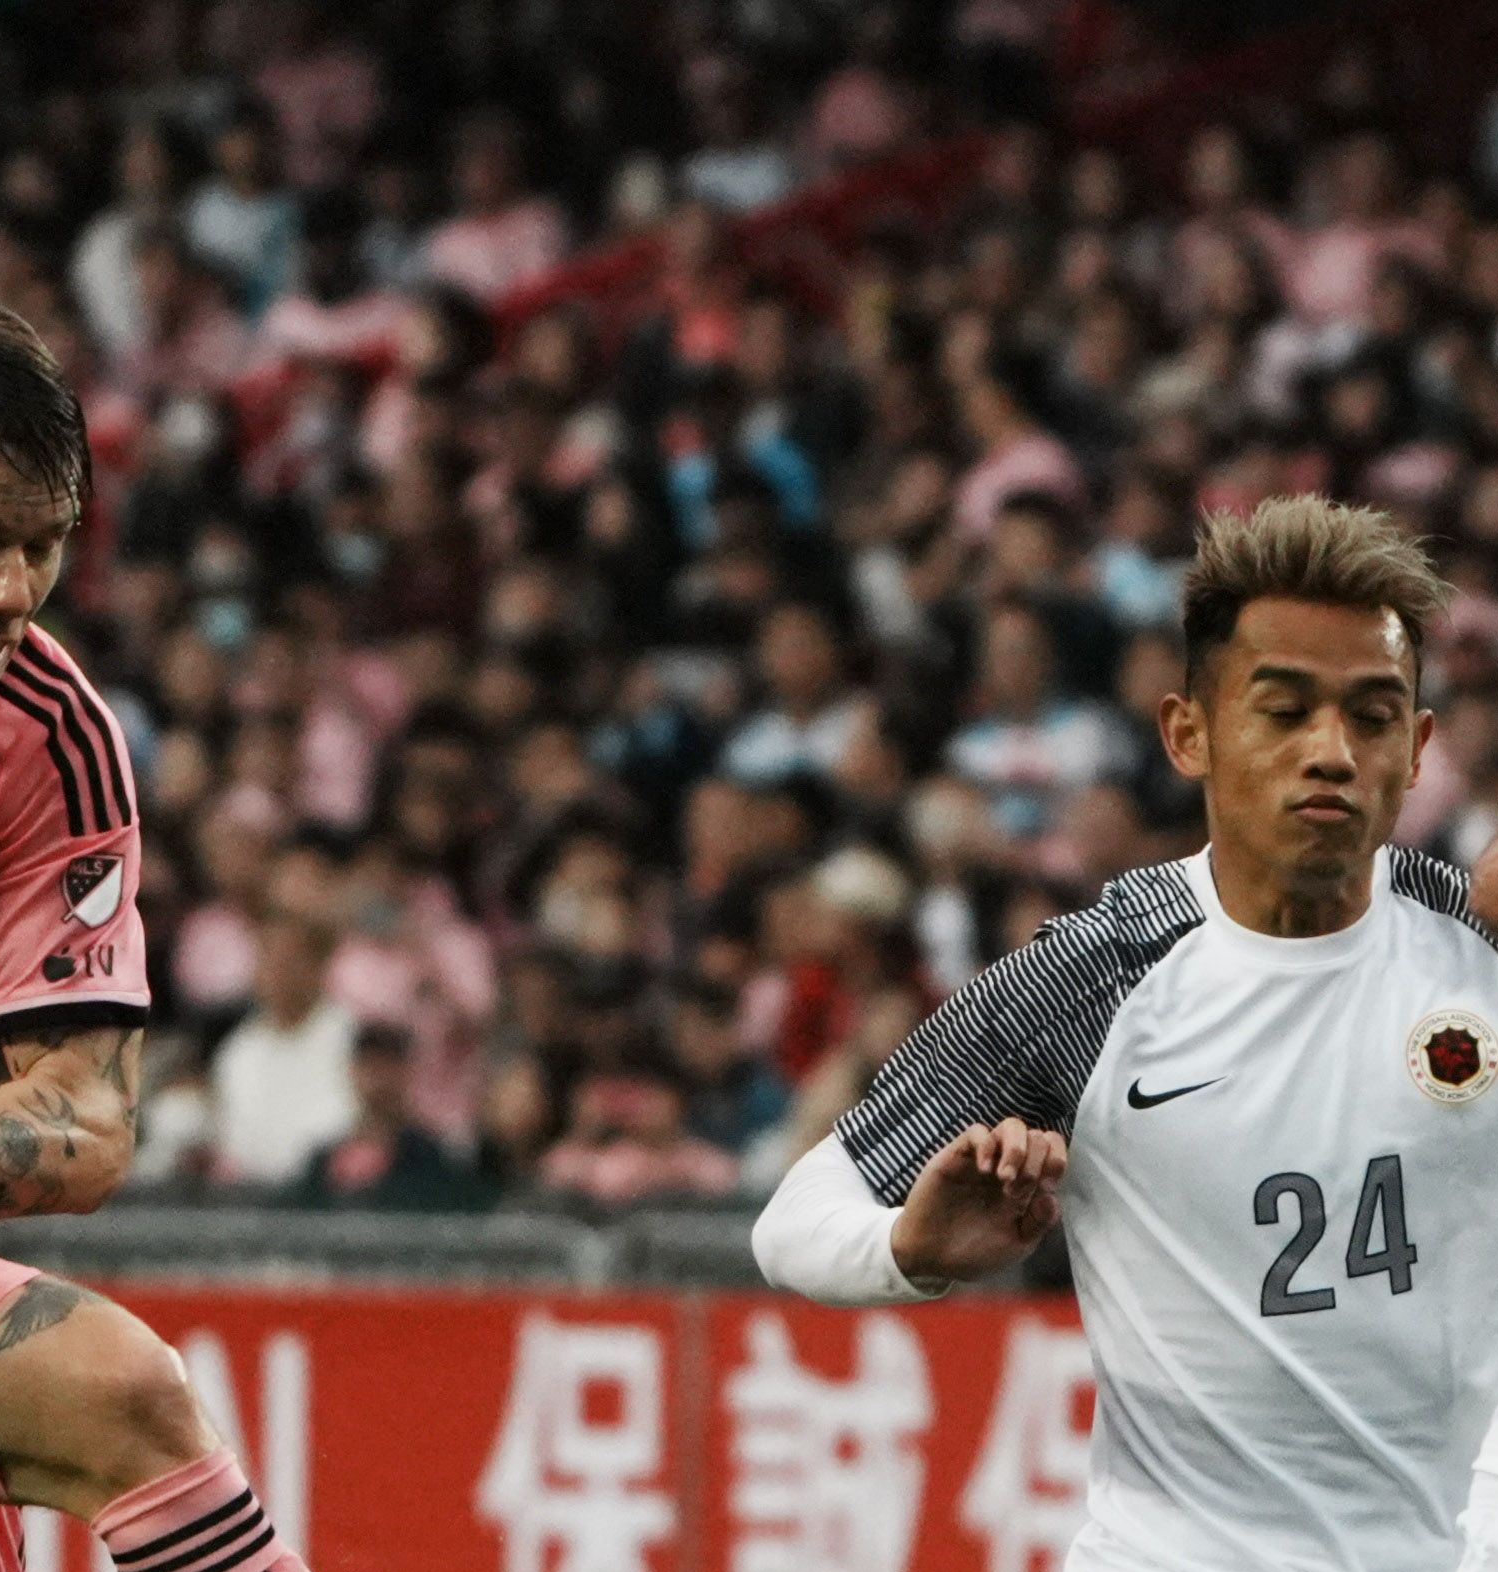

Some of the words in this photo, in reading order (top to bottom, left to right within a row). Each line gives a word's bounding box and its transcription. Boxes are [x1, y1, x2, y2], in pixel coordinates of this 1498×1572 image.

[1416, 1014, 1449, 1039] FOOTBALL
[1449, 1013, 1492, 1043] ASSOCIATION
[1470, 1074, 1492, 1095] CHINA
[1253, 1154, 1418, 1317] 24
